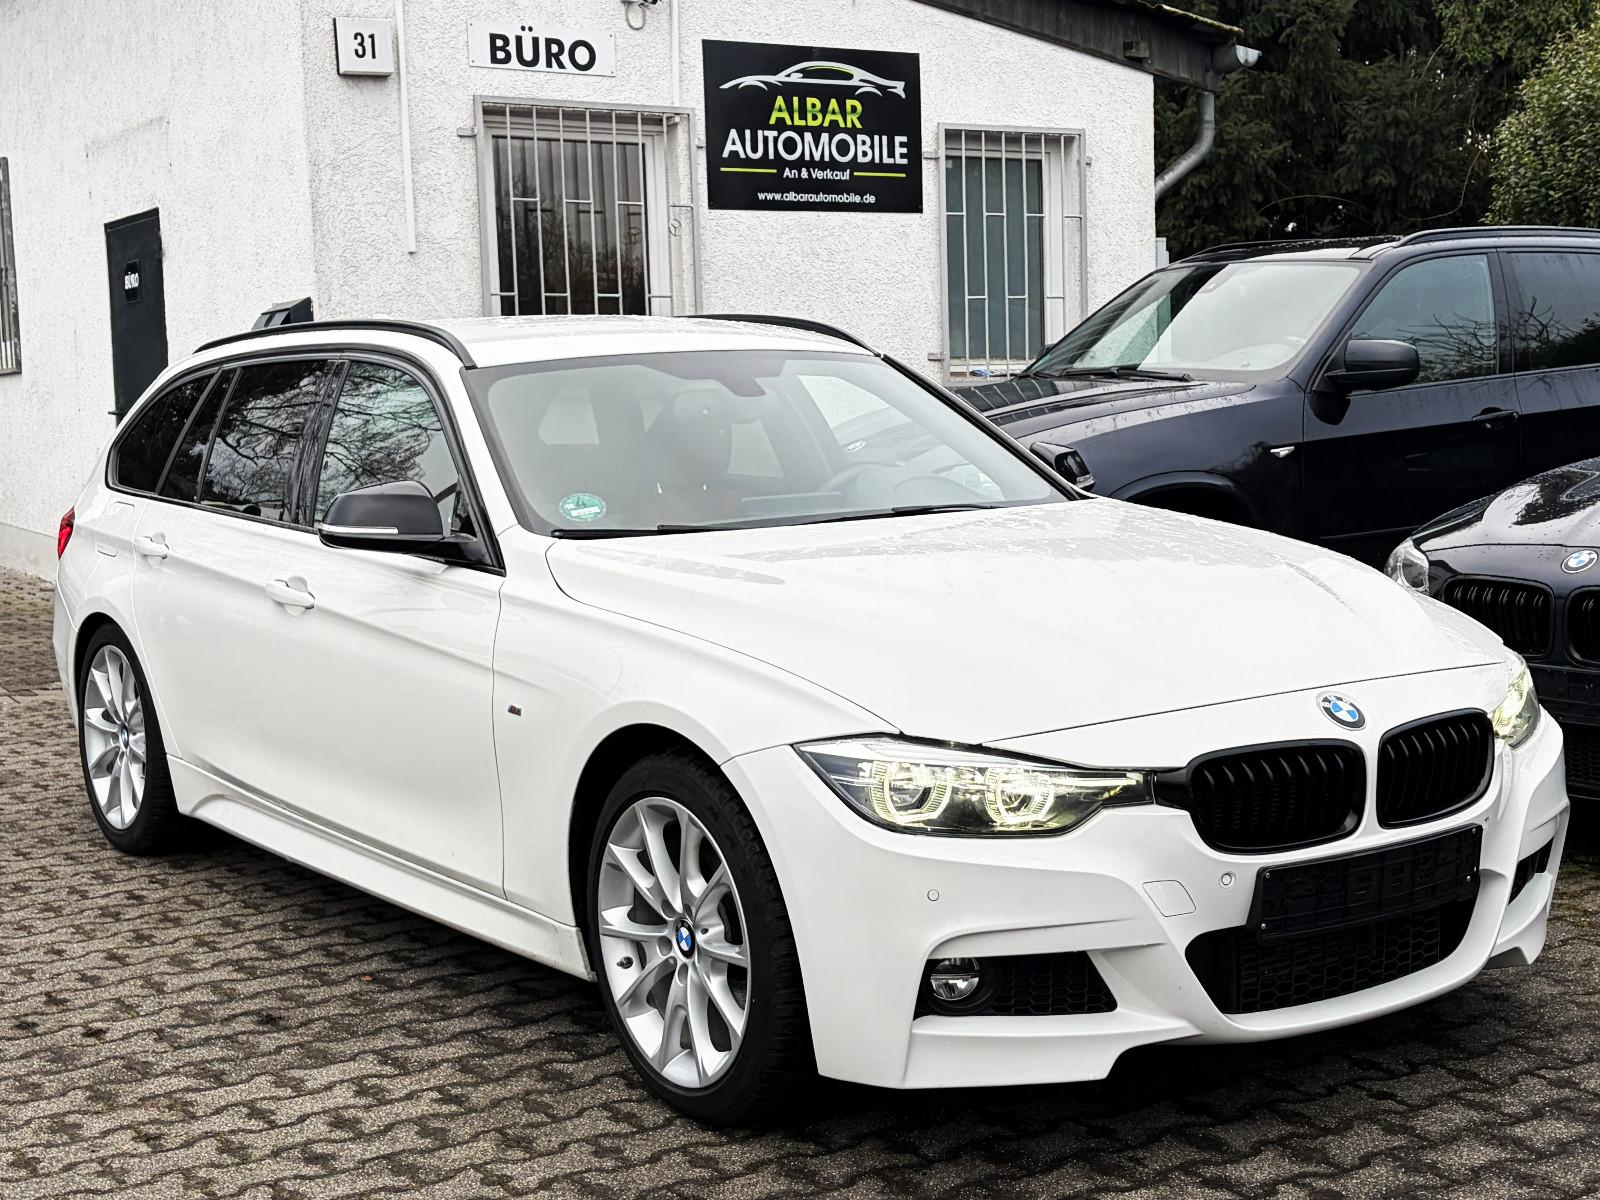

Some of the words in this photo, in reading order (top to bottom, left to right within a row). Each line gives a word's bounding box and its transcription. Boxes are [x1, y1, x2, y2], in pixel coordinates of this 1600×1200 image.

[353, 31, 377, 60] 31
[488, 25, 597, 72] BÜRO
[768, 95, 863, 129] ALBAR
[721, 128, 909, 165] AUTOMOBILE
[783, 167, 798, 178] An
[800, 167, 809, 179] &
[810, 168, 850, 180] Verkauf
[757, 191, 876, 203] www.albarautomobile.de
